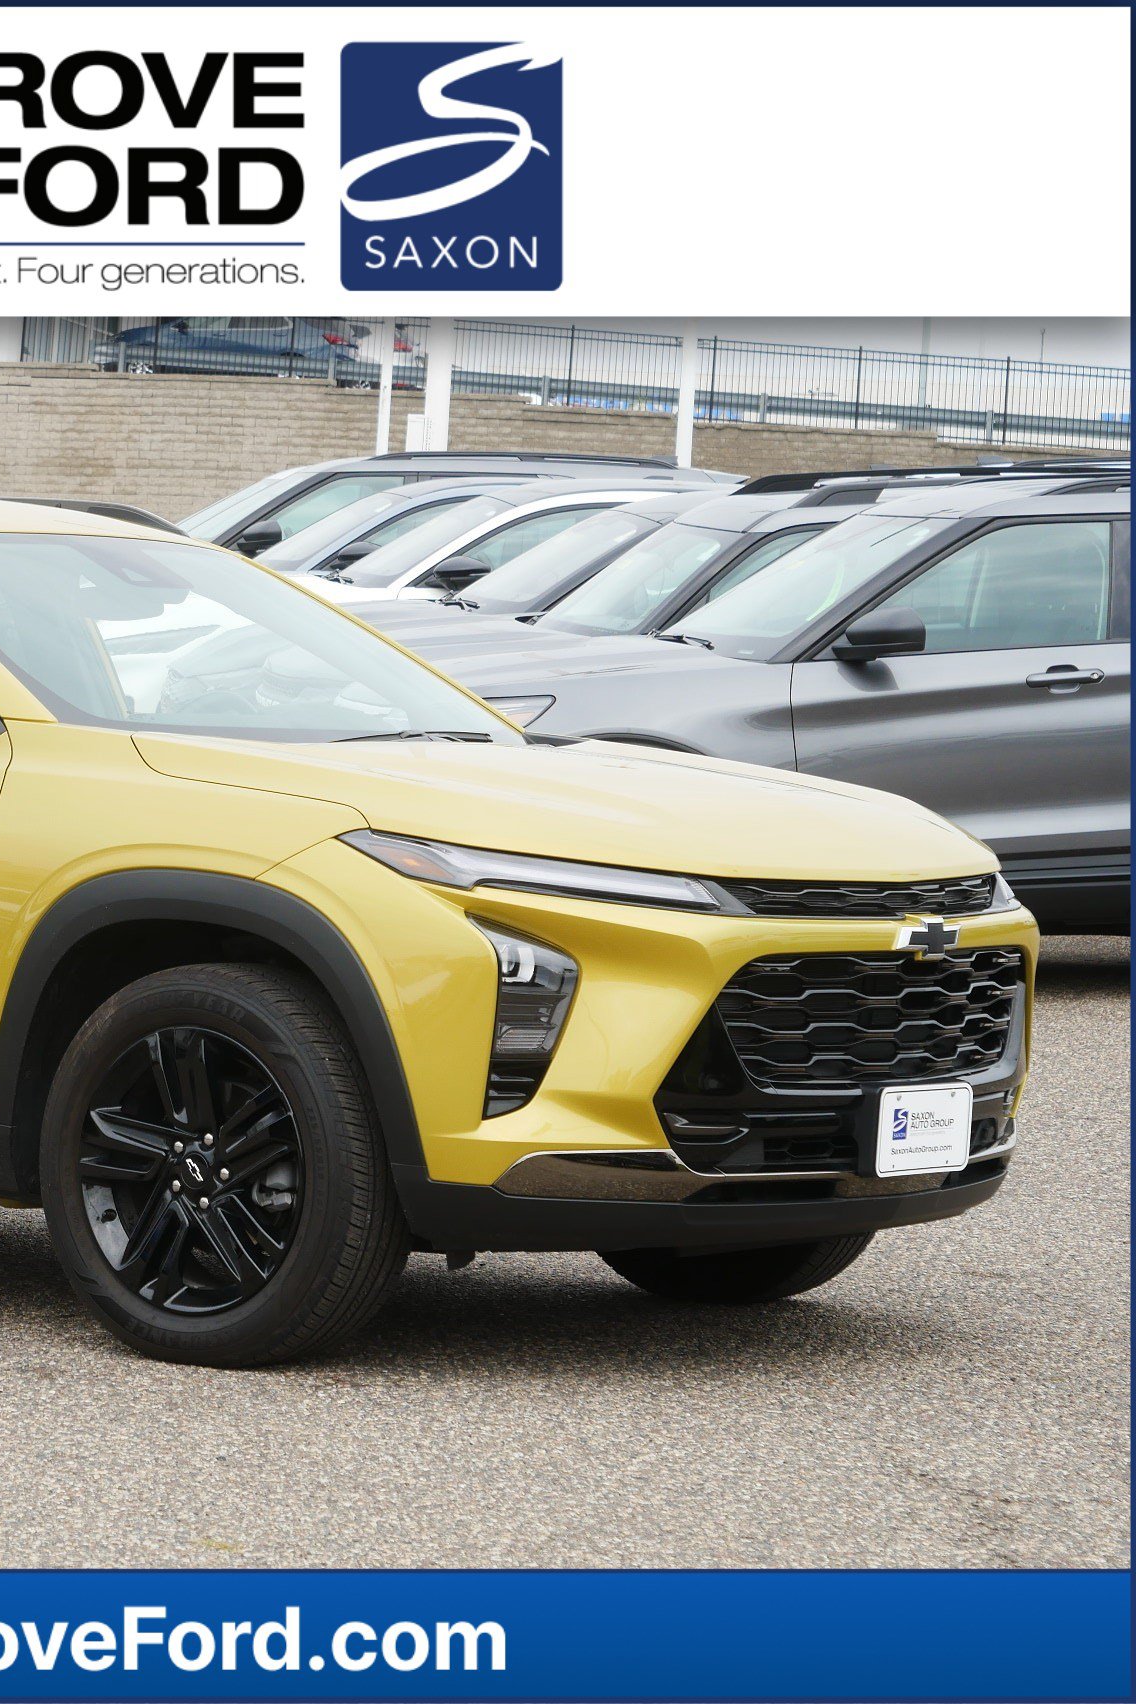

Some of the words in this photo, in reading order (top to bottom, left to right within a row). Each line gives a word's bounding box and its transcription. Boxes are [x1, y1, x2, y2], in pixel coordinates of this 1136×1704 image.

[911, 1111, 935, 1121] SAXON
[910, 1120, 929, 1129] AUTO
[930, 1118, 955, 1128] GROUP
[890, 1144, 953, 1155] SaxonAutoGroup.com
